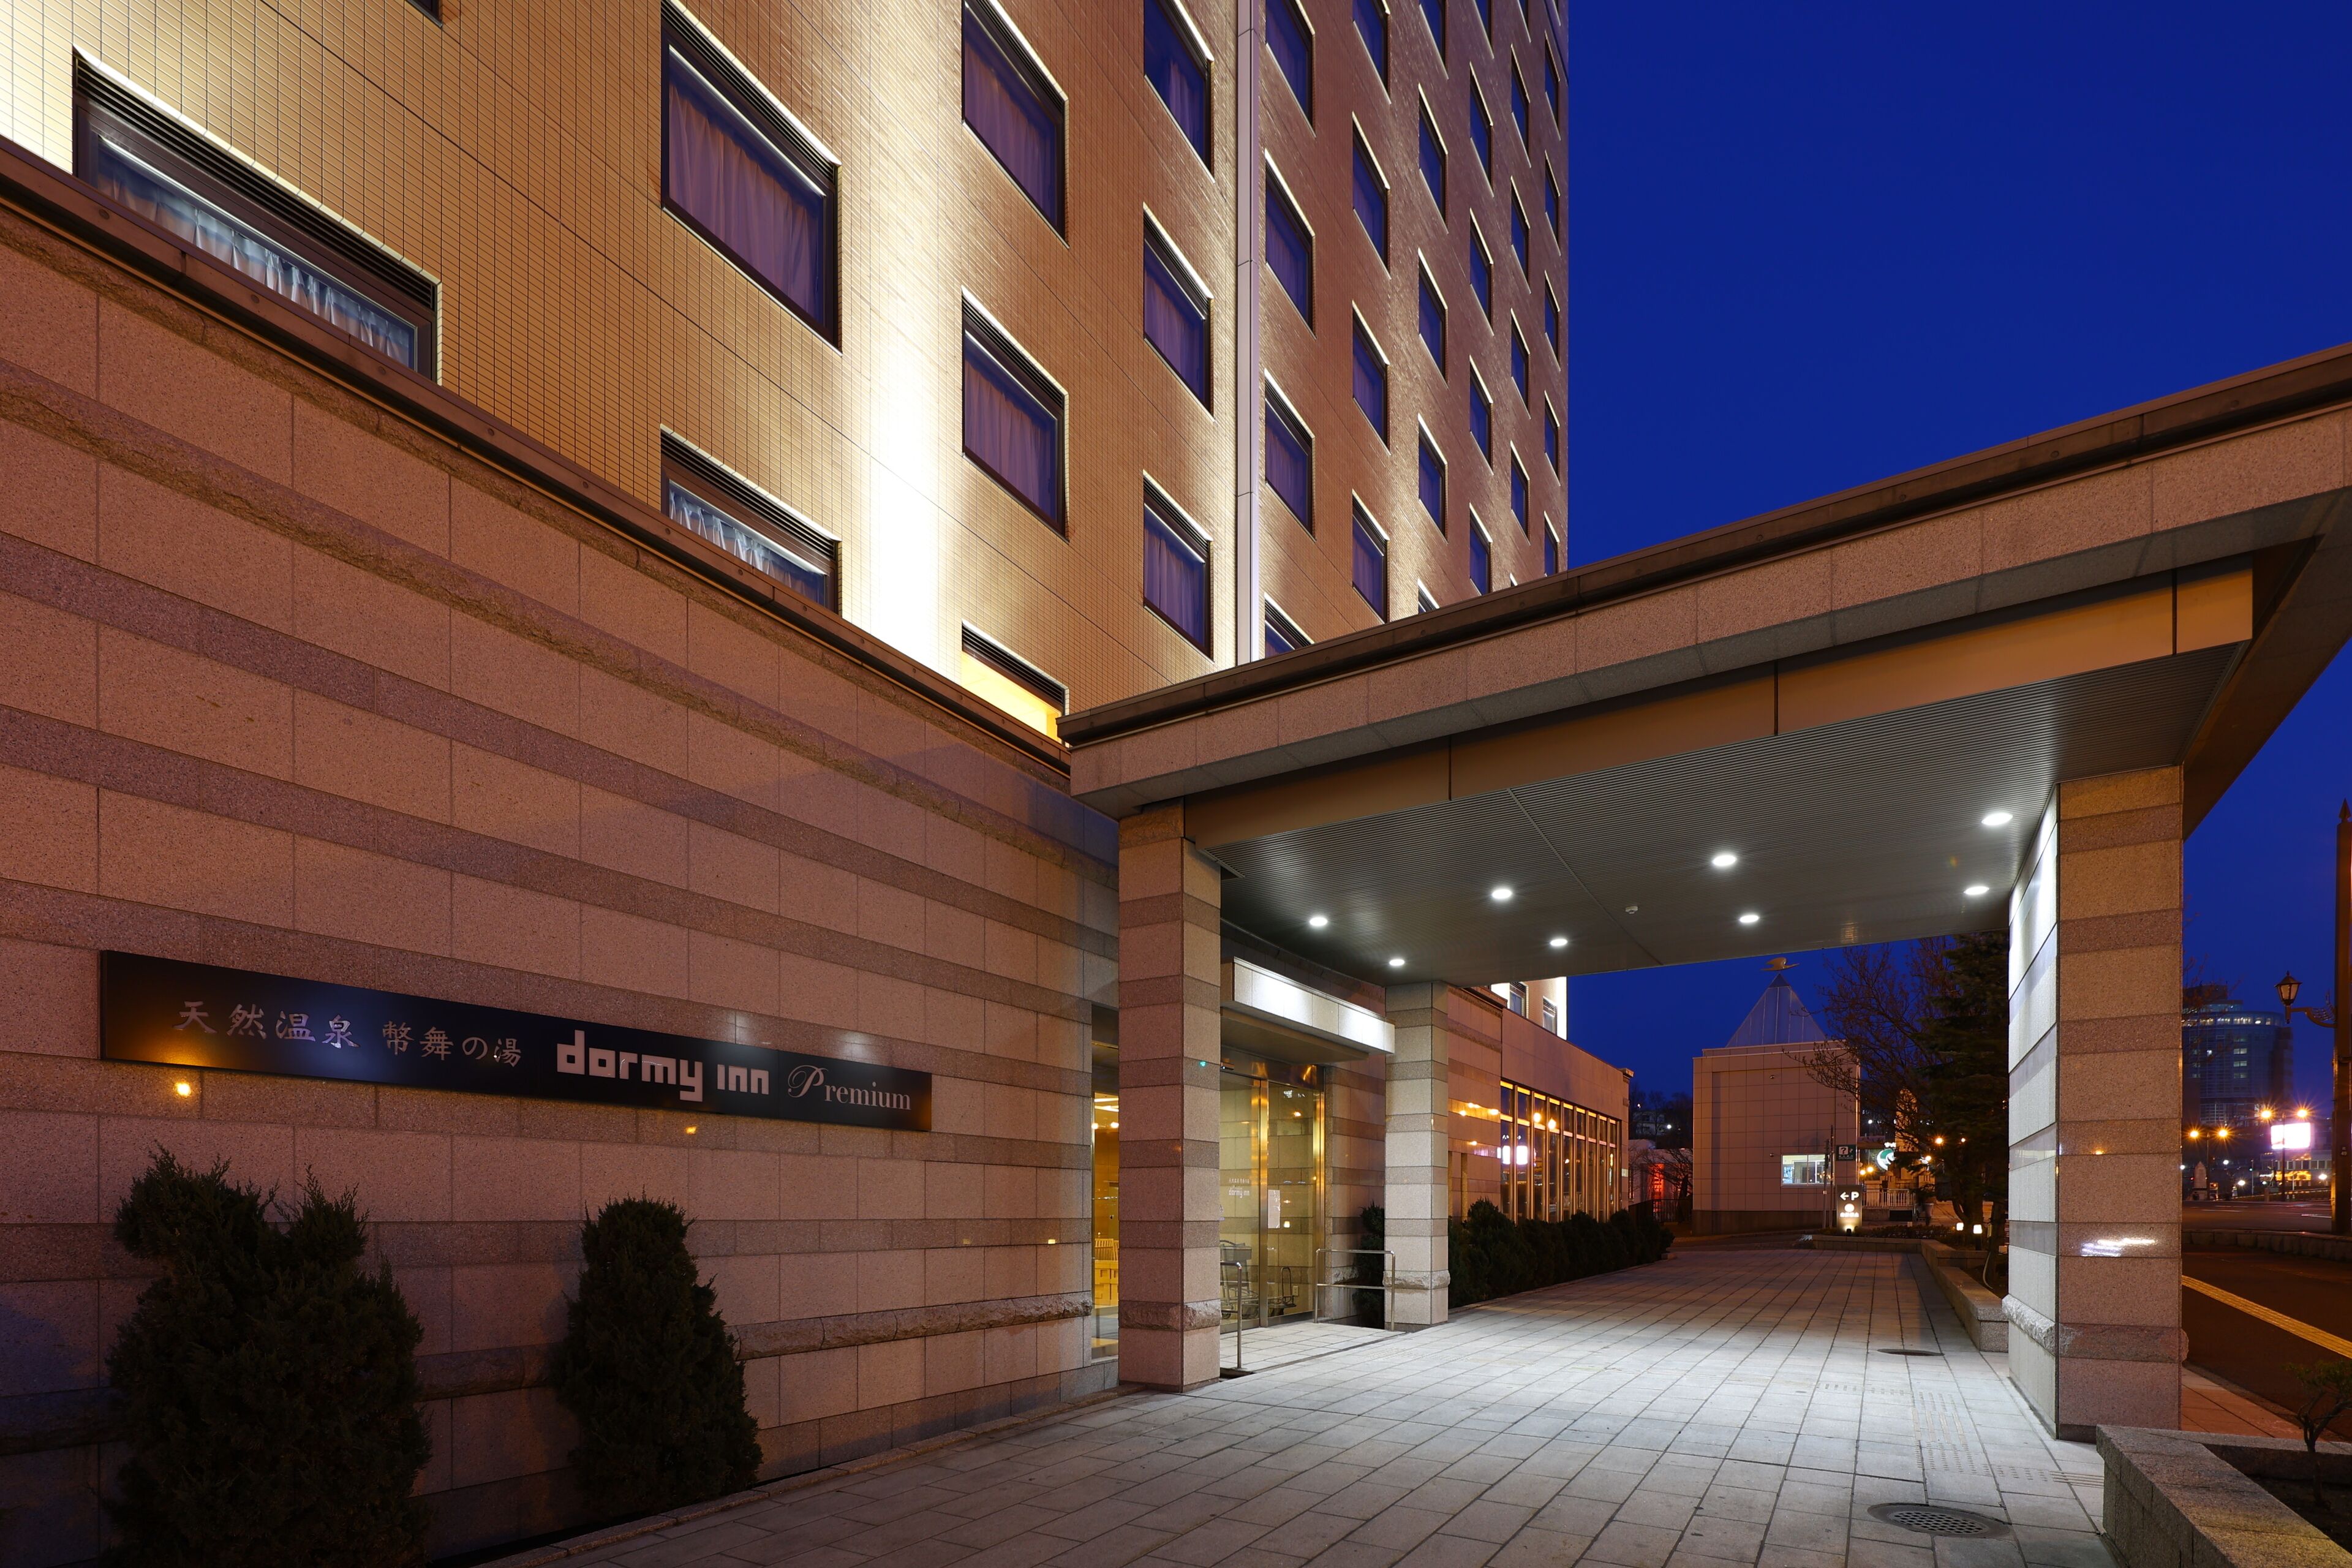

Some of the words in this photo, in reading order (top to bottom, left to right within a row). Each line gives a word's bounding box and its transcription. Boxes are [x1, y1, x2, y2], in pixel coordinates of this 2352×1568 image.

[174, 1001, 360, 1049] 天然温泉
[383, 1020, 522, 1067] 幣舞の湯
[557, 1030, 703, 1102] dormy
[717, 1064, 769, 1095] inn
[788, 1065, 911, 1110] Premium
[1229, 1188, 1243, 1198] dormy
[1851, 1191, 1860, 1200] P
